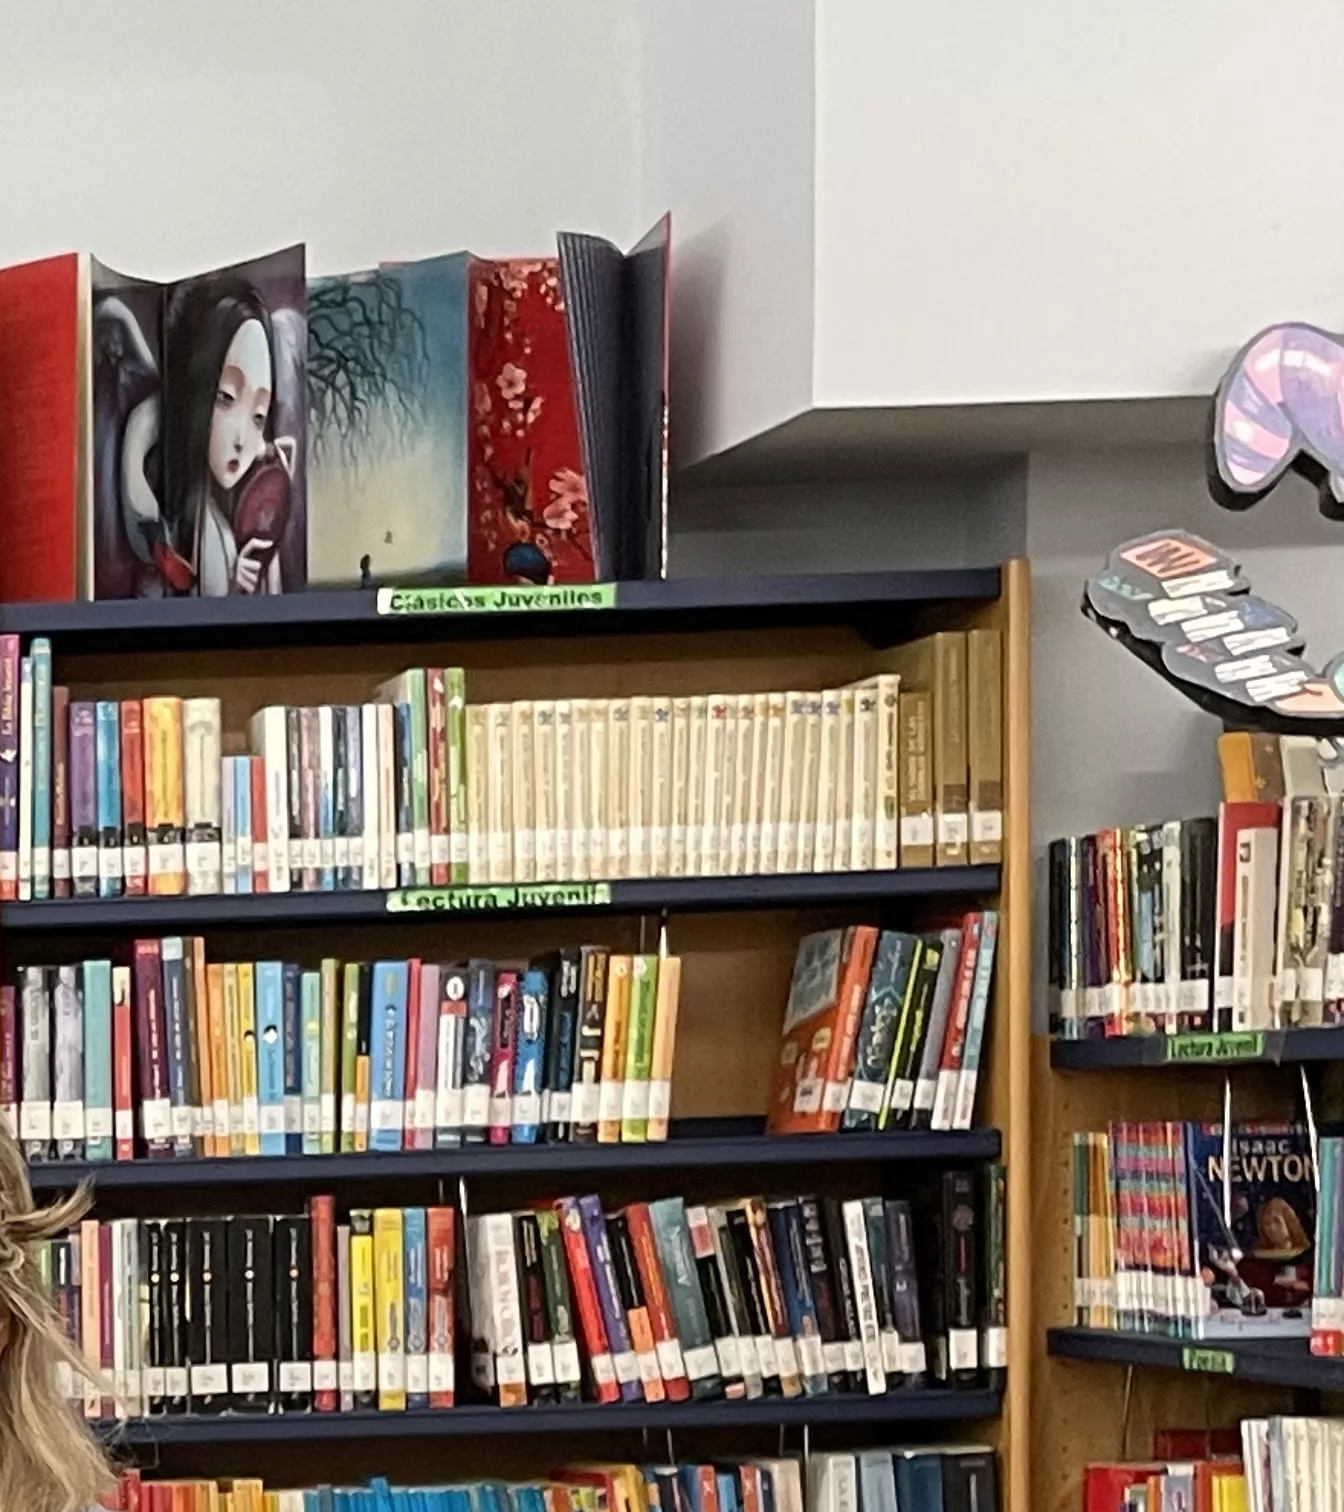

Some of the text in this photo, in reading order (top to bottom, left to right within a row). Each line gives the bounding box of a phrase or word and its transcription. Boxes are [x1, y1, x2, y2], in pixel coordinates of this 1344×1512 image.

[494, 591, 603, 609] Juveniles
[401, 884, 597, 909] Lectura Juvenil
[1232, 1139, 1290, 1156] Isaac
